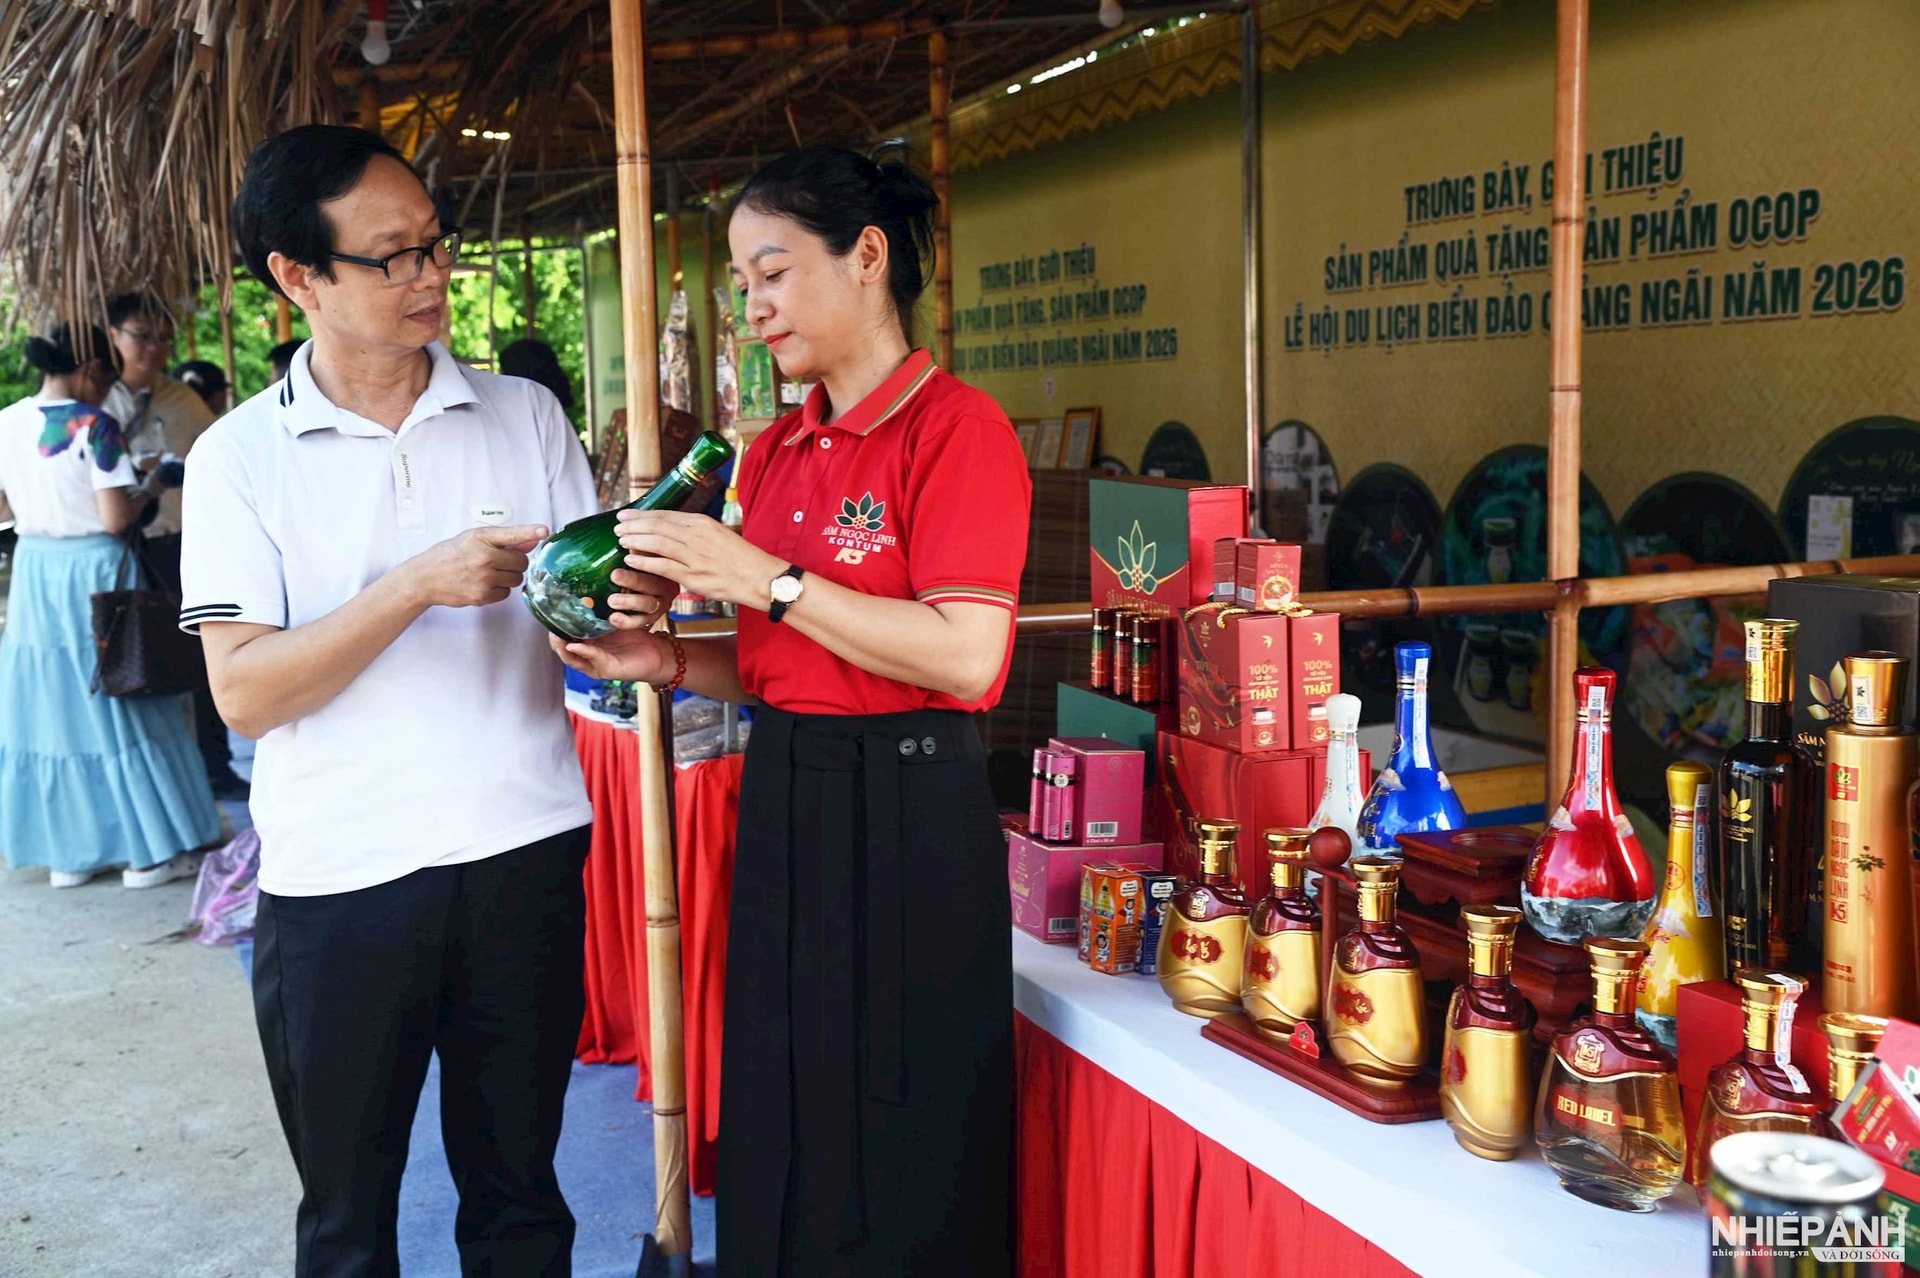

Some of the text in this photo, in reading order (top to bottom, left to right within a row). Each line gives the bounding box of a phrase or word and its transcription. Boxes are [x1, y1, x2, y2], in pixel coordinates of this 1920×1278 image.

[1404, 131, 1684, 223] TRƯNG BÀY, GI THIỆU
[1324, 242, 1363, 291] SẢN
[1368, 231, 1428, 286] PHẨM
[1434, 230, 1478, 282] QUÀ
[1583, 206, 1621, 262] ẢN
[1630, 188, 1718, 256] PHẨM
[1728, 189, 1821, 246] OCOP
[1113, 283, 1147, 317] OCOP
[1285, 303, 1304, 348] LỄ
[1310, 305, 1339, 355] HỘI
[1345, 309, 1370, 345] DU
[1376, 303, 1421, 353] LỊCH
[1427, 285, 1478, 337] BIỂN
[1484, 282, 1533, 334] ĐẢO
[1641, 269, 1712, 324] NGÃI
[1723, 262, 1801, 319] NĂM
[1812, 257, 1905, 312] 2026
[1146, 327, 1177, 358] 2026
[828, 536, 882, 553] KONTUM
[839, 528, 870, 543] NGỌC
[871, 534, 896, 547] LINH
[834, 547, 868, 565] K5
[1248, 664, 1279, 676] 100%
[1303, 660, 1333, 671] 100%
[1248, 686, 1279, 701] THẬT
[1303, 681, 1333, 697] THẬT
[1831, 903, 1847, 921] K5
[1557, 1094, 1617, 1127] RED LABEL
